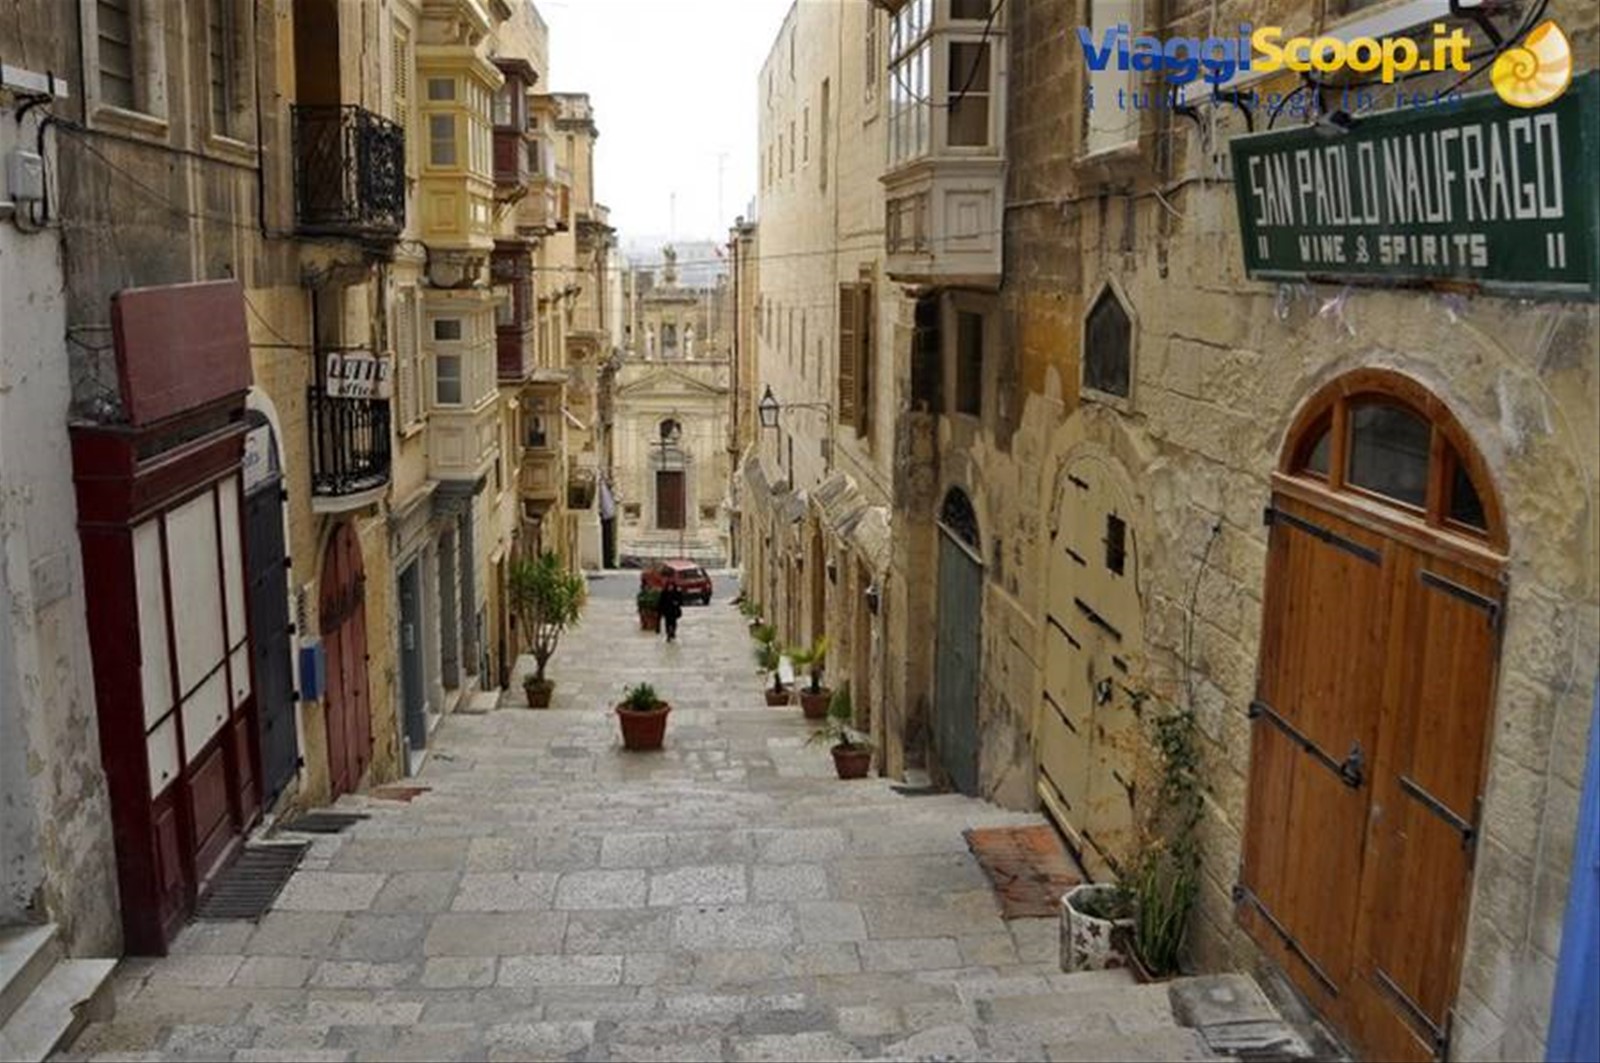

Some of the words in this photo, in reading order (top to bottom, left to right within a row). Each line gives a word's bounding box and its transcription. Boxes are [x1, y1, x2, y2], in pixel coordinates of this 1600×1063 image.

[1250, 155, 1295, 227] SAN
[1299, 142, 1380, 226] PAOLO
[1384, 113, 1565, 226] NAUFRAGO
[1299, 235, 1347, 263] WINE
[1379, 233, 1488, 268] SPIRITS
